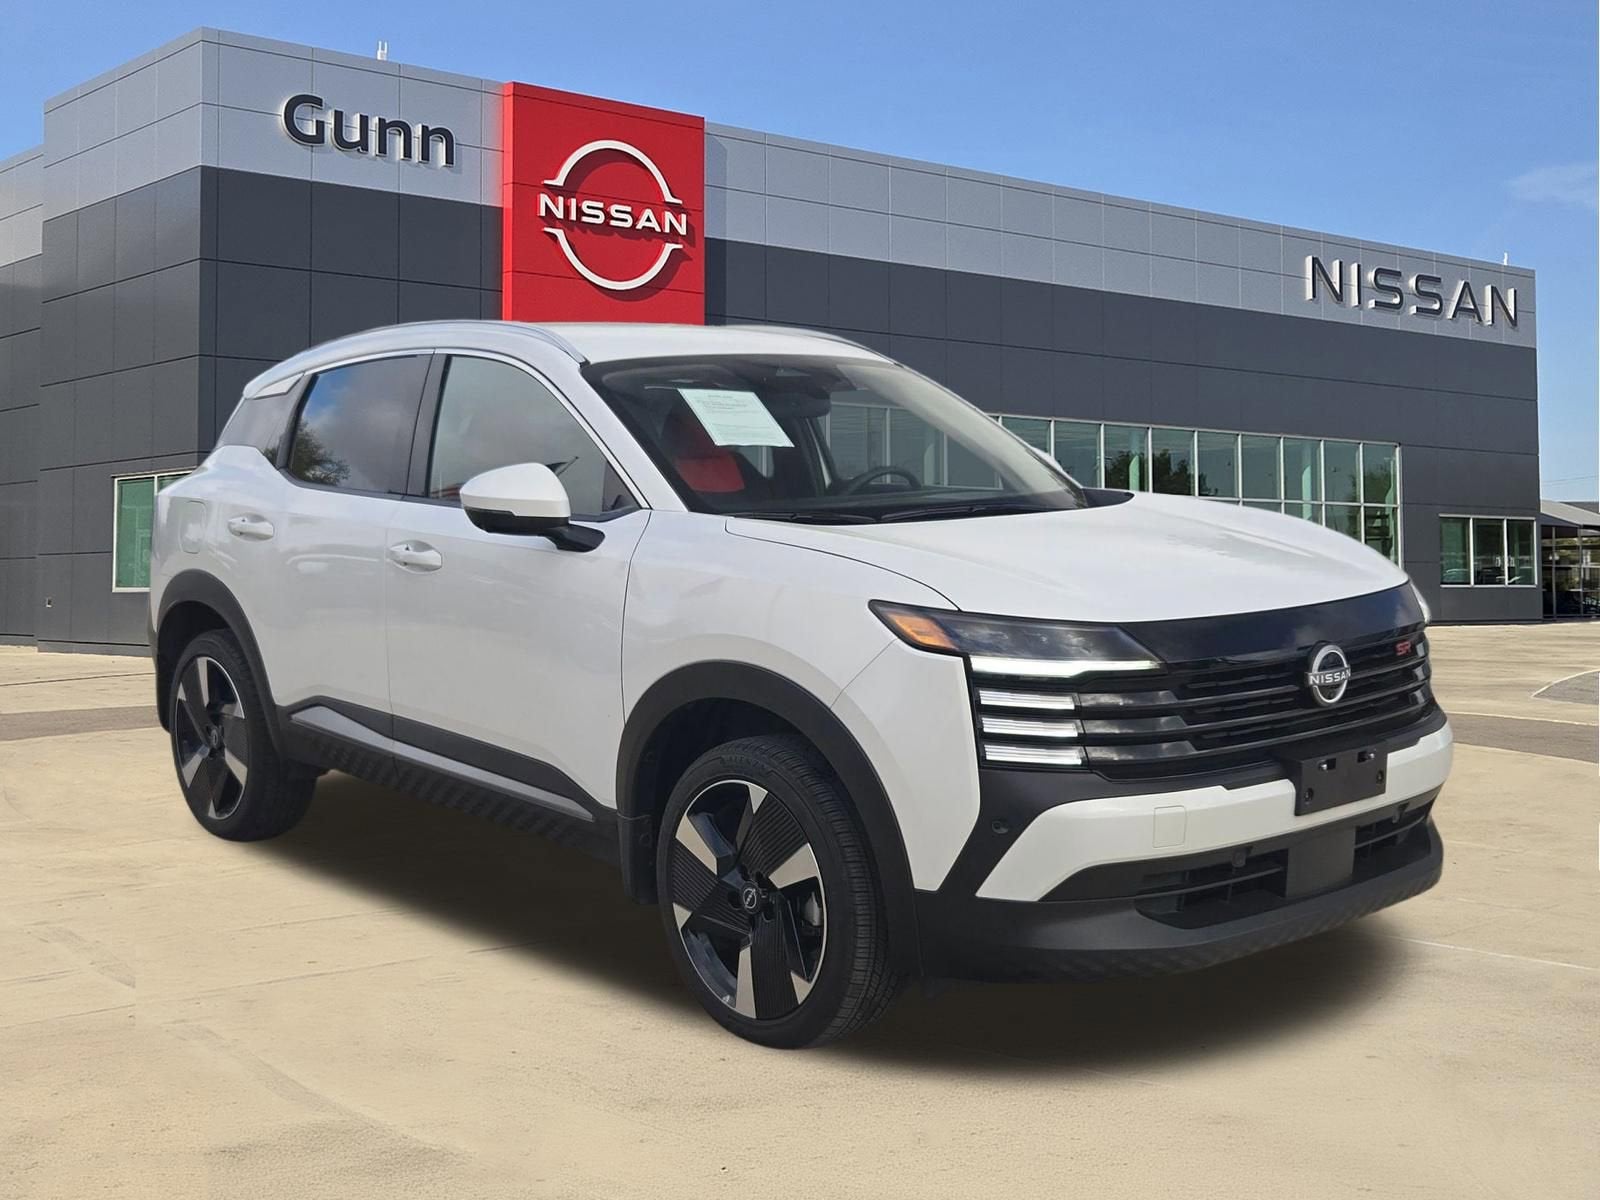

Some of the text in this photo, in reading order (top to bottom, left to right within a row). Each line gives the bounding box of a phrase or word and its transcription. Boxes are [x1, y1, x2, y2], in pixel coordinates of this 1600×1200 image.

[282, 94, 455, 167] Gunn
[538, 193, 687, 235] NISSAN
[1306, 255, 1517, 327] NISSAN
[1395, 640, 1412, 655] SR
[1308, 667, 1351, 685] NISSAN
